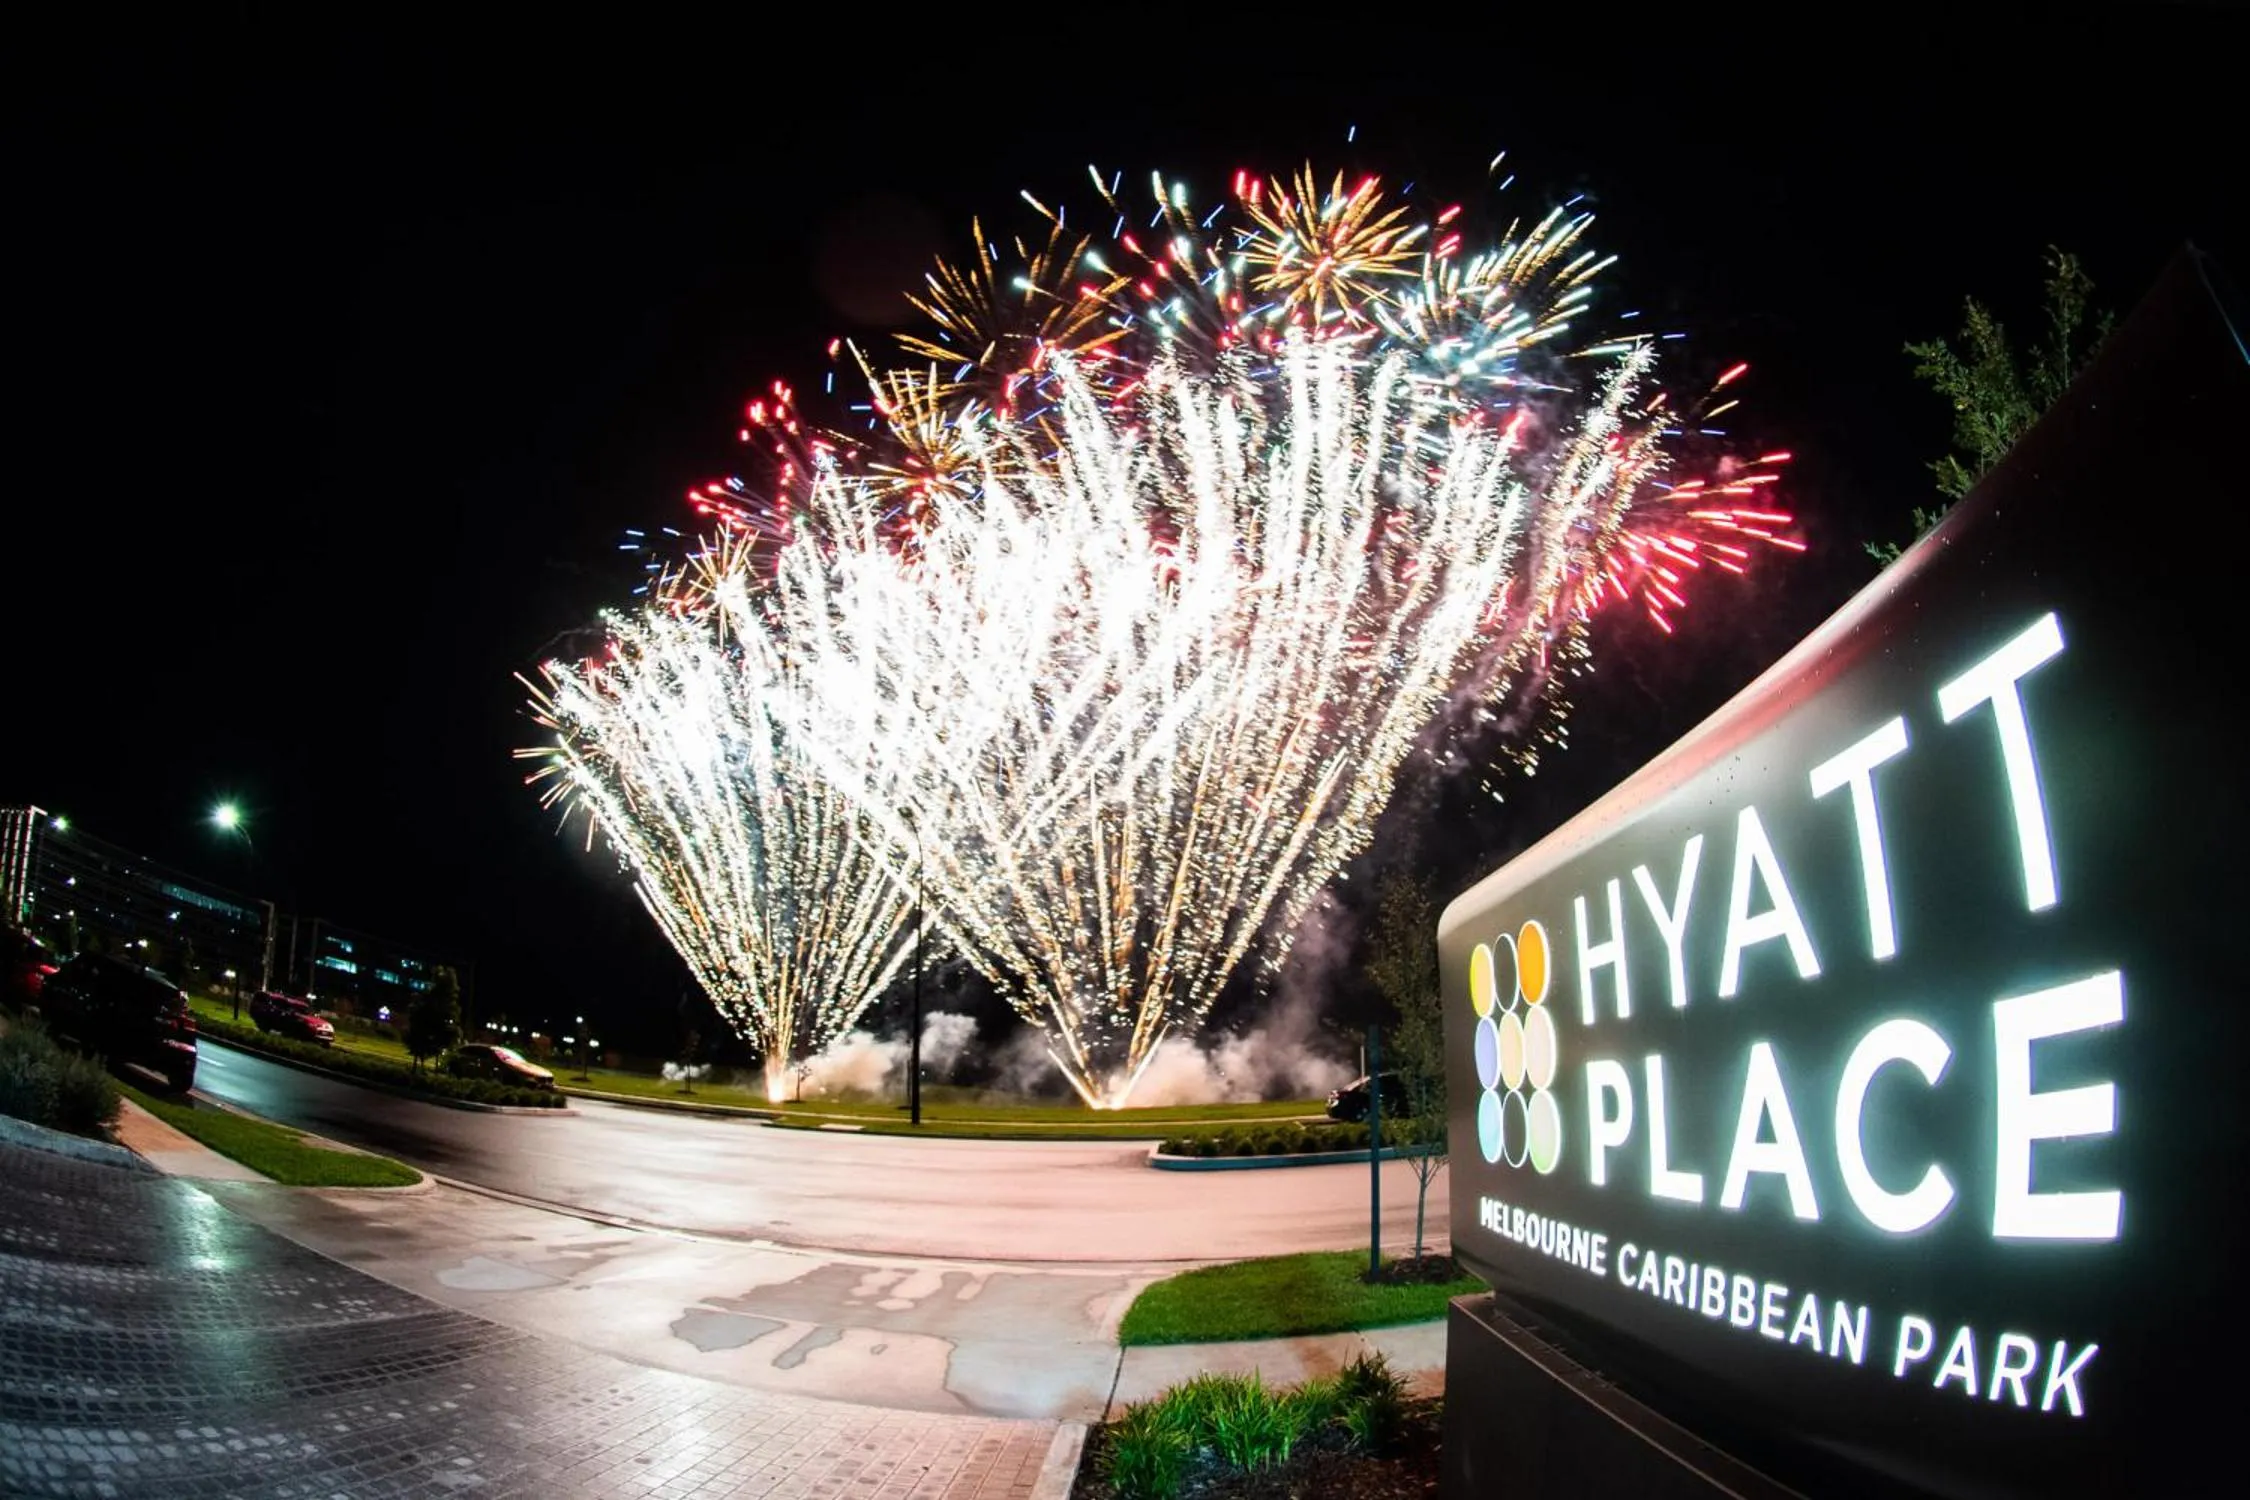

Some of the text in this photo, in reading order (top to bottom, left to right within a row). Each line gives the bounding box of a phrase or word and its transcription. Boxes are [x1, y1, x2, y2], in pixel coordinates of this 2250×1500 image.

[1574, 612, 2065, 1025] HYATT
[1584, 970, 2124, 1239] PLACE
[1479, 1196, 2099, 1417] MELBOURNE CARIBBEAN PARK
